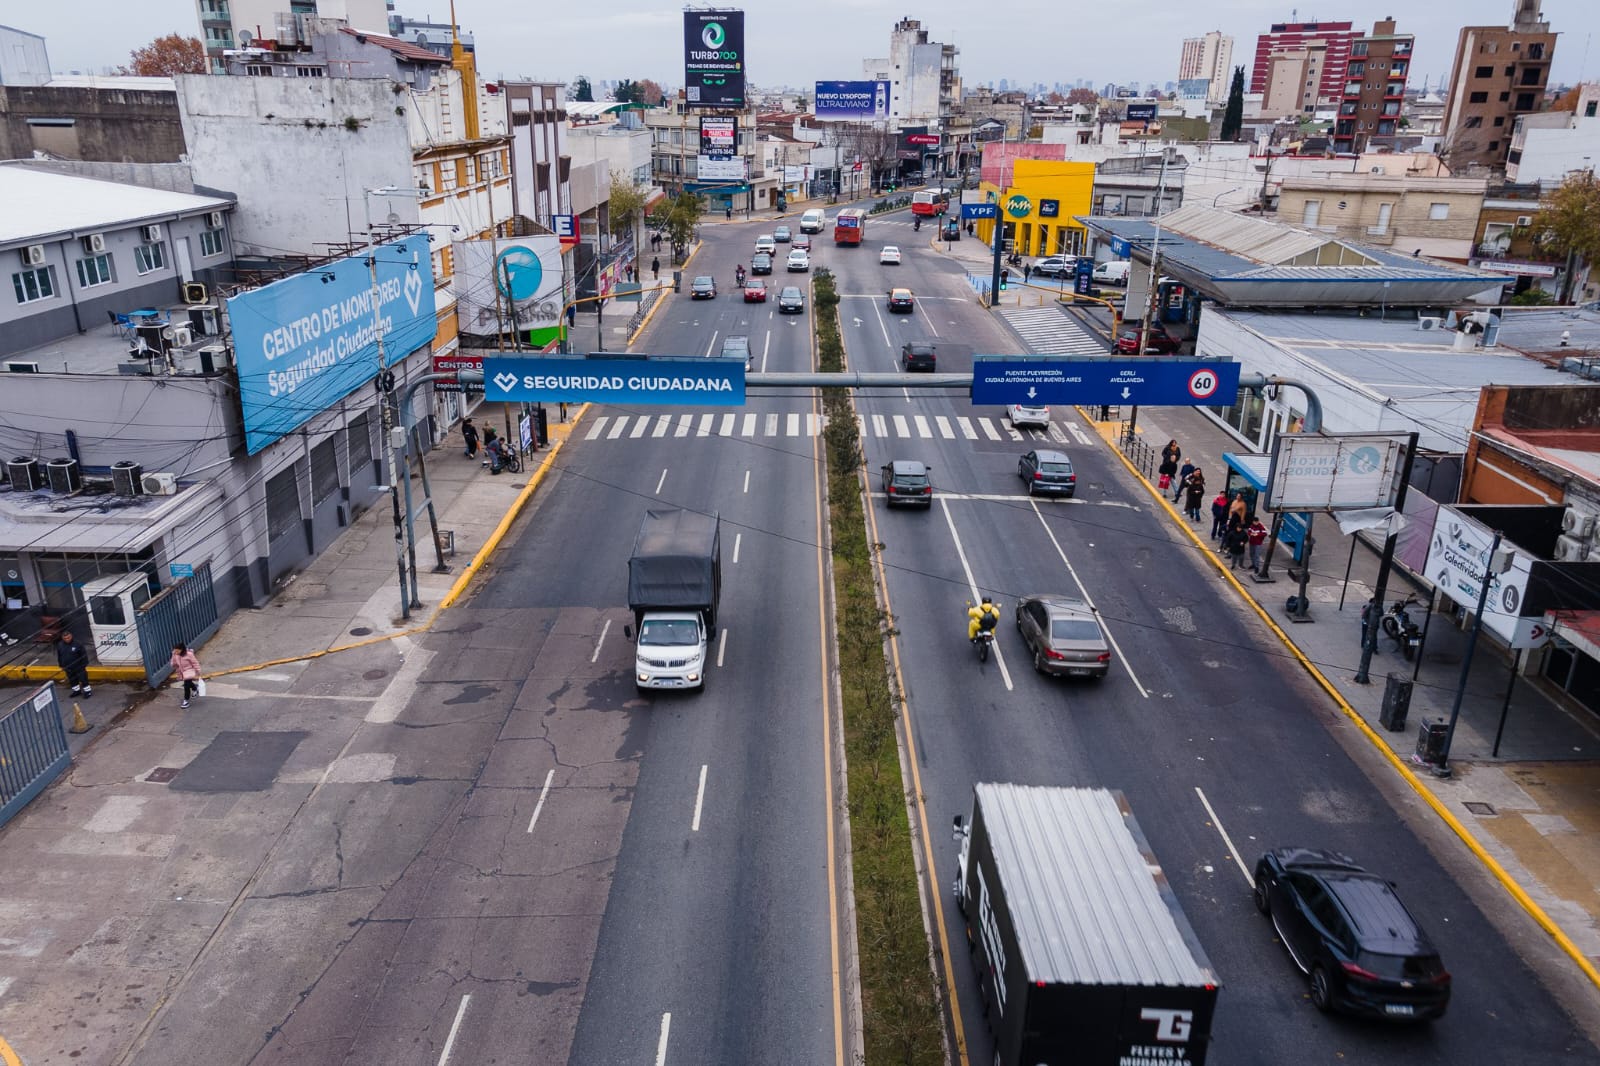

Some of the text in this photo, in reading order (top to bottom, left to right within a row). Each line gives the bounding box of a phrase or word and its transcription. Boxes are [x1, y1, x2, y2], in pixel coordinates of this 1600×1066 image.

[690, 51, 737, 60] TURBO700
[817, 100, 870, 108] ULTRALIVIANO
[970, 207, 993, 215] YPF
[555, 216, 571, 235] E
[263, 277, 401, 361] CENTRO DE MONITOREO
[268, 338, 335, 397] Seguridad
[438, 361, 483, 369] CENTRO D
[523, 376, 733, 391] SEGURIDAD CIUDADANA
[1195, 376, 1211, 390] 60
[1444, 551, 1485, 583] Colectividad
[1141, 1007, 1193, 1042] TG
[1131, 1045, 1186, 1059] FLETES Y
[1120, 1056, 1192, 1066] MUDANZAS
